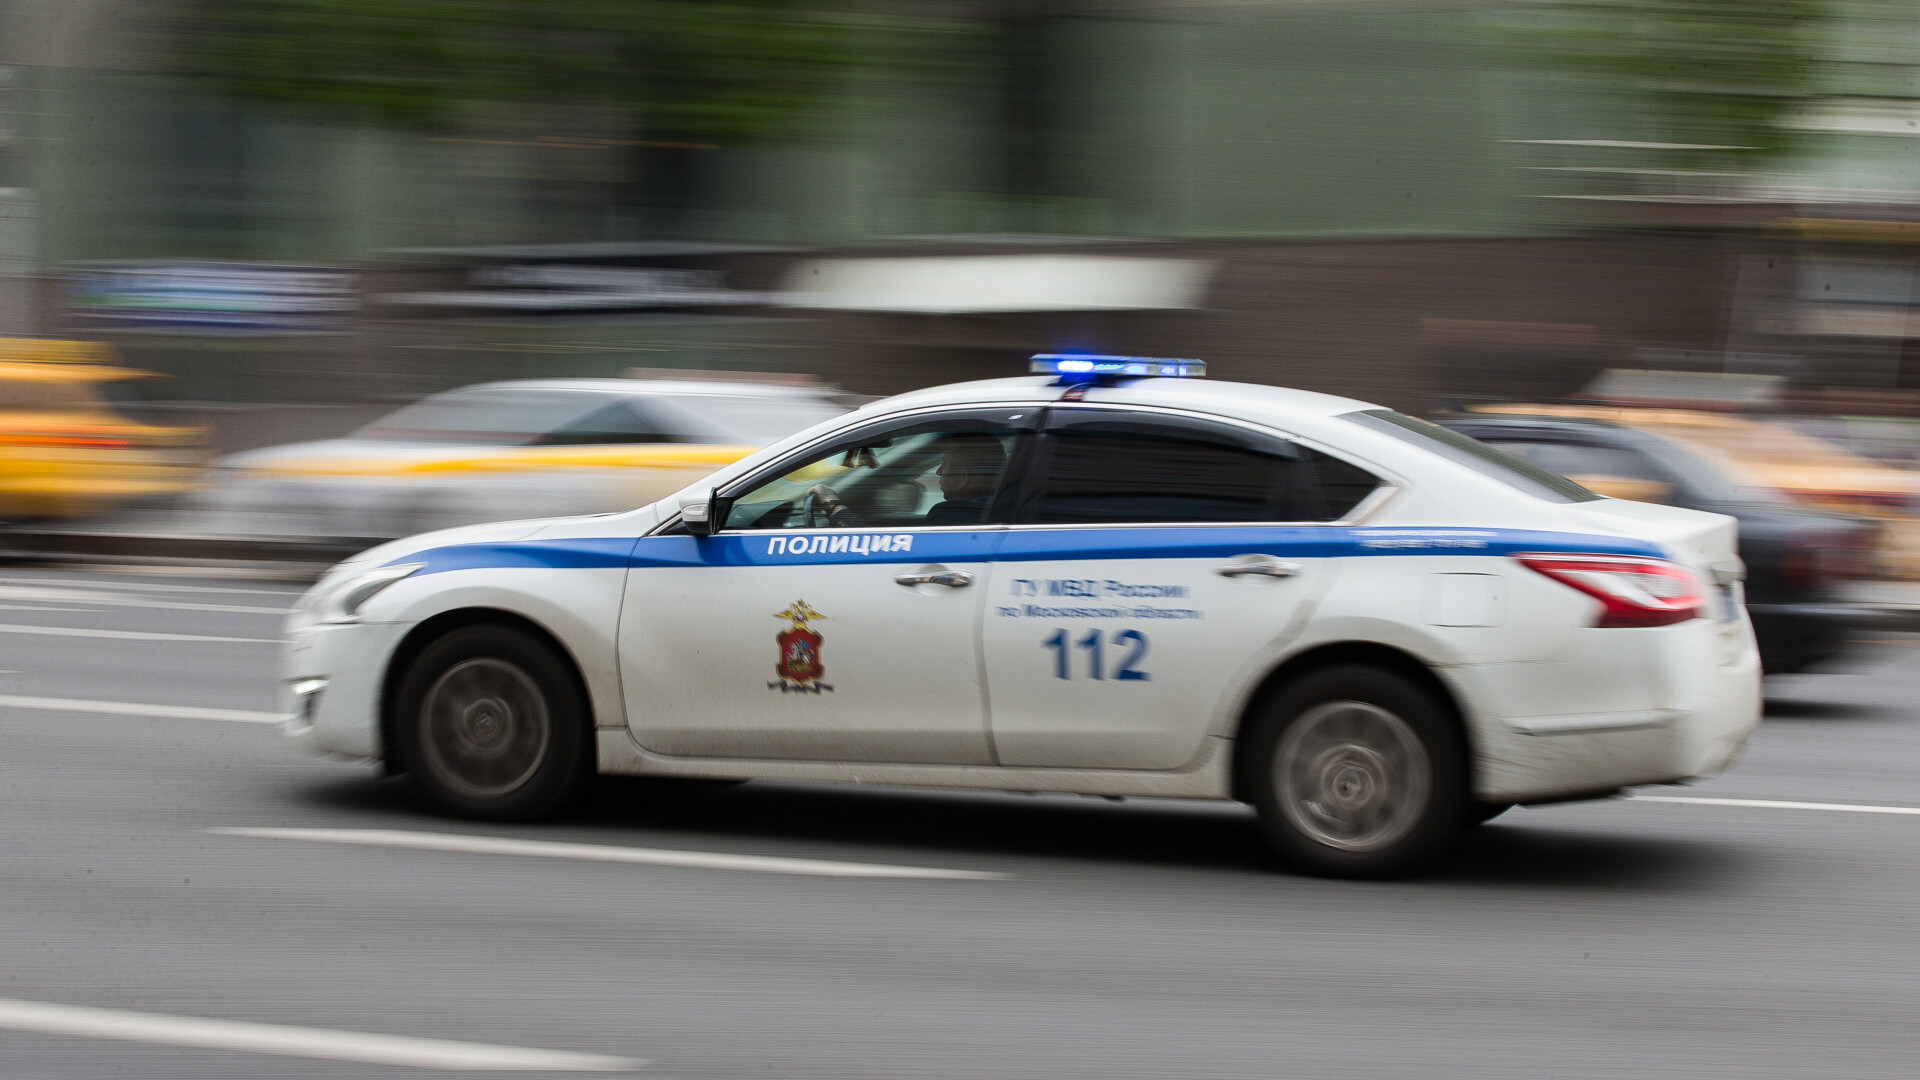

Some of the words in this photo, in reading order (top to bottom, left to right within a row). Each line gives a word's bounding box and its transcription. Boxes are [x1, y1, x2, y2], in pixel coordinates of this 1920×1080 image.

[767, 534, 914, 556] ПОЛИЦИЯ
[1010, 578, 1039, 597] ГУ
[1044, 579, 1101, 600] МВД
[1103, 579, 1191, 599] России
[1042, 627, 1152, 682] 112
